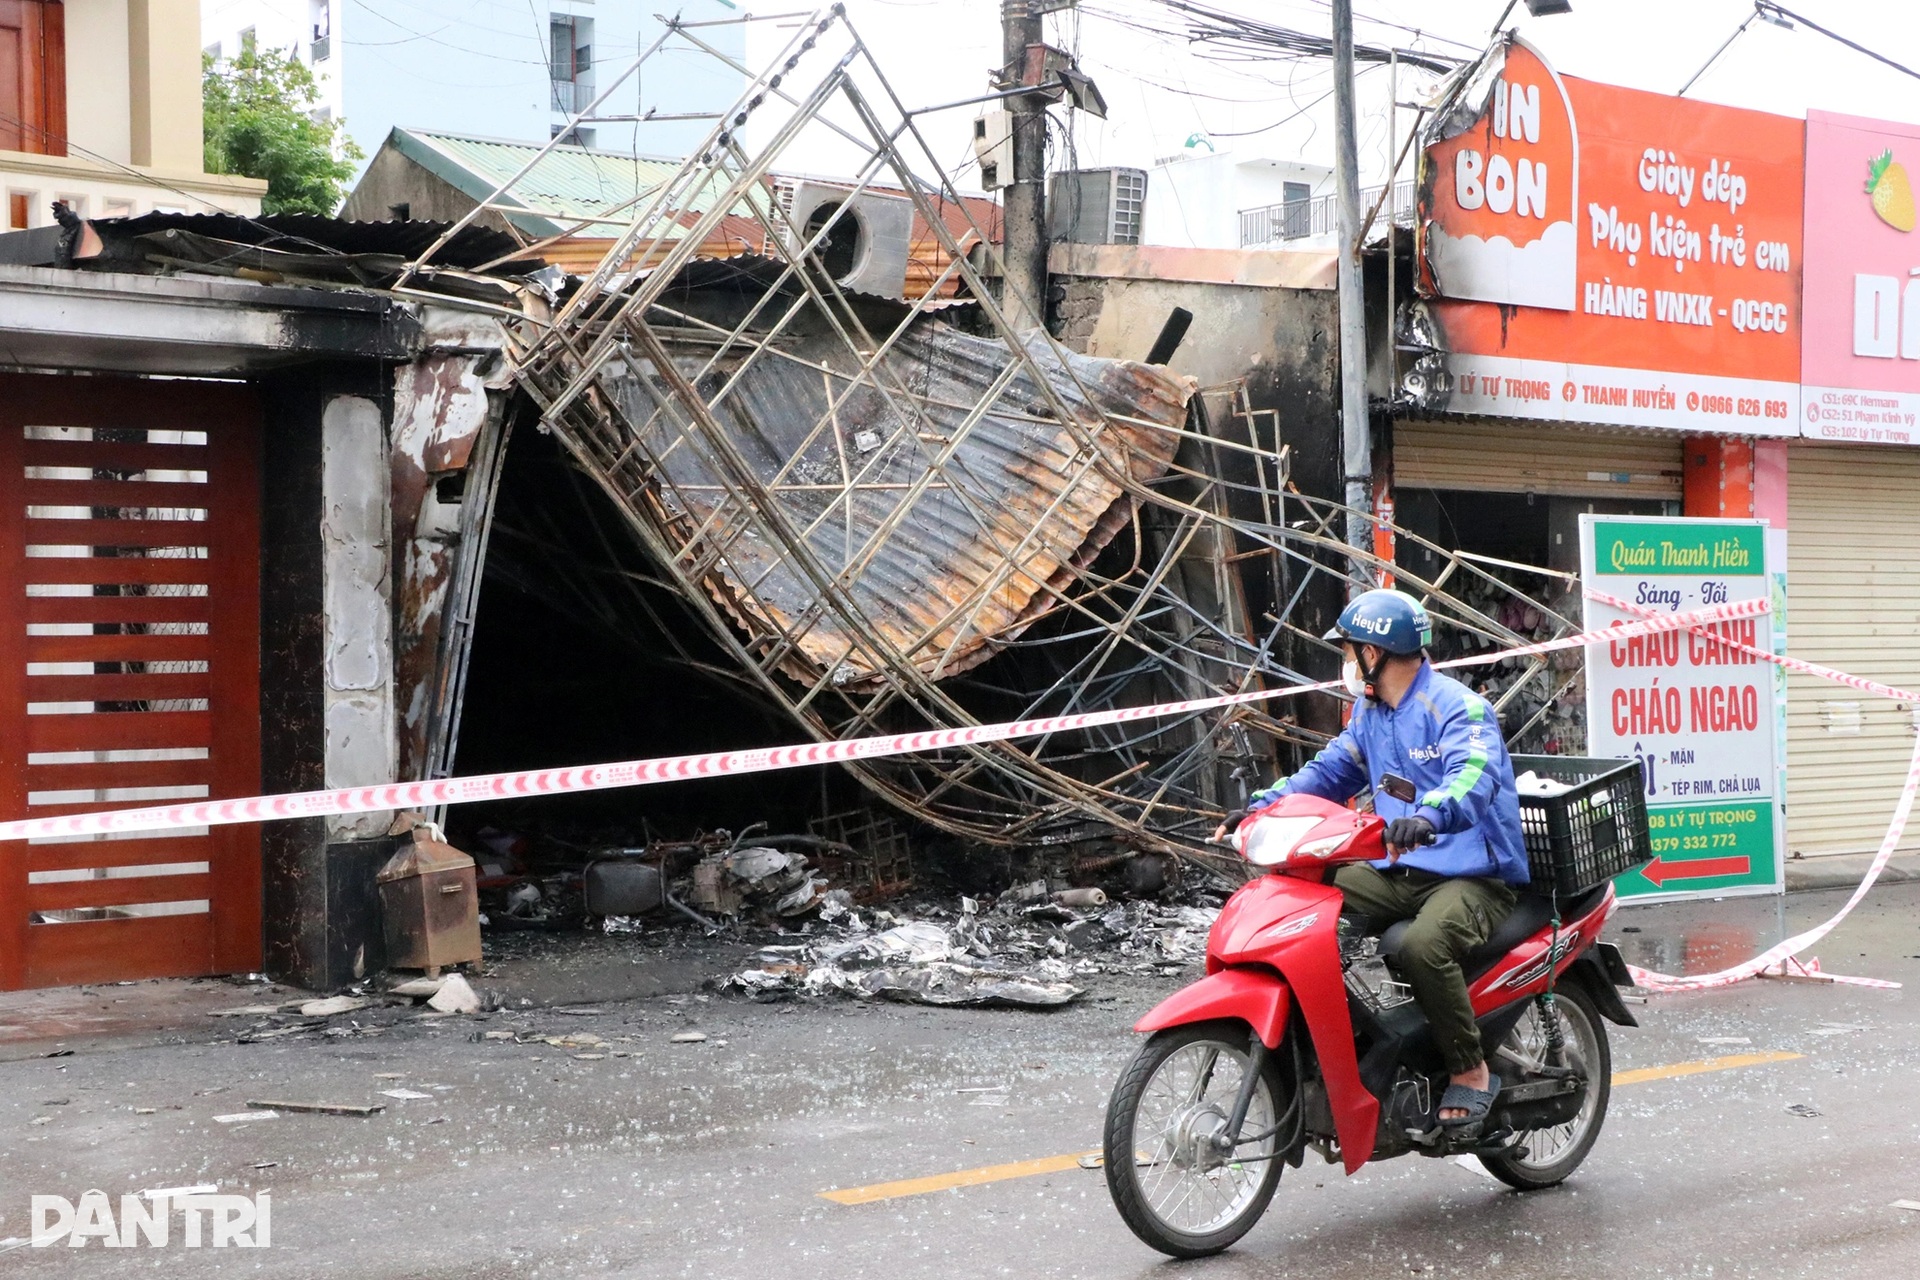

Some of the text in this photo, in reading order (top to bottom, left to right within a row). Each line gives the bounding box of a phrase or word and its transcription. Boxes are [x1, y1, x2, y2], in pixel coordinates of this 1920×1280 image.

[1456, 149, 1547, 219] BON
[1639, 148, 1746, 214] Giày dép
[1588, 202, 1790, 273] Phụ kiện trẻ em
[1584, 276, 1648, 320] HÀNG
[1654, 290, 1713, 326] VNXK
[1731, 299, 1787, 333] QCCC
[1460, 371, 1476, 395] LÝ
[1481, 375, 1501, 401] TỰ
[1505, 378, 1550, 403] TRỌNG
[1582, 383, 1676, 410] THANH HUYỀN
[1822, 393, 1840, 405] CS1:
[1860, 396, 1899, 408] Hermann
[1701, 395, 1787, 419] 0966 626 693
[1821, 409, 1840, 421] CS2:
[1842, 410, 1853, 421] 51
[1855, 411, 1879, 424] Phạm
[1821, 425, 1840, 438] CS3:
[1841, 427, 1858, 438] 102
[1611, 537, 1750, 572] Quán Thanh Hiền
[1636, 581, 1682, 611] Sáng
[1701, 581, 1728, 605] Tối
[1688, 619, 1756, 667] CANH
[1612, 677, 1758, 736] CHÁO NGAO
[1670, 748, 1694, 767] MẶN
[1672, 774, 1760, 795] TÉP RIM, CHẢ LỤA
[1670, 810, 1685, 827] LÝ
[1689, 811, 1705, 829] TỰ
[1709, 809, 1756, 827] TRỌNG
[1683, 836, 1708, 849] 332
[1712, 833, 1736, 847] 772
